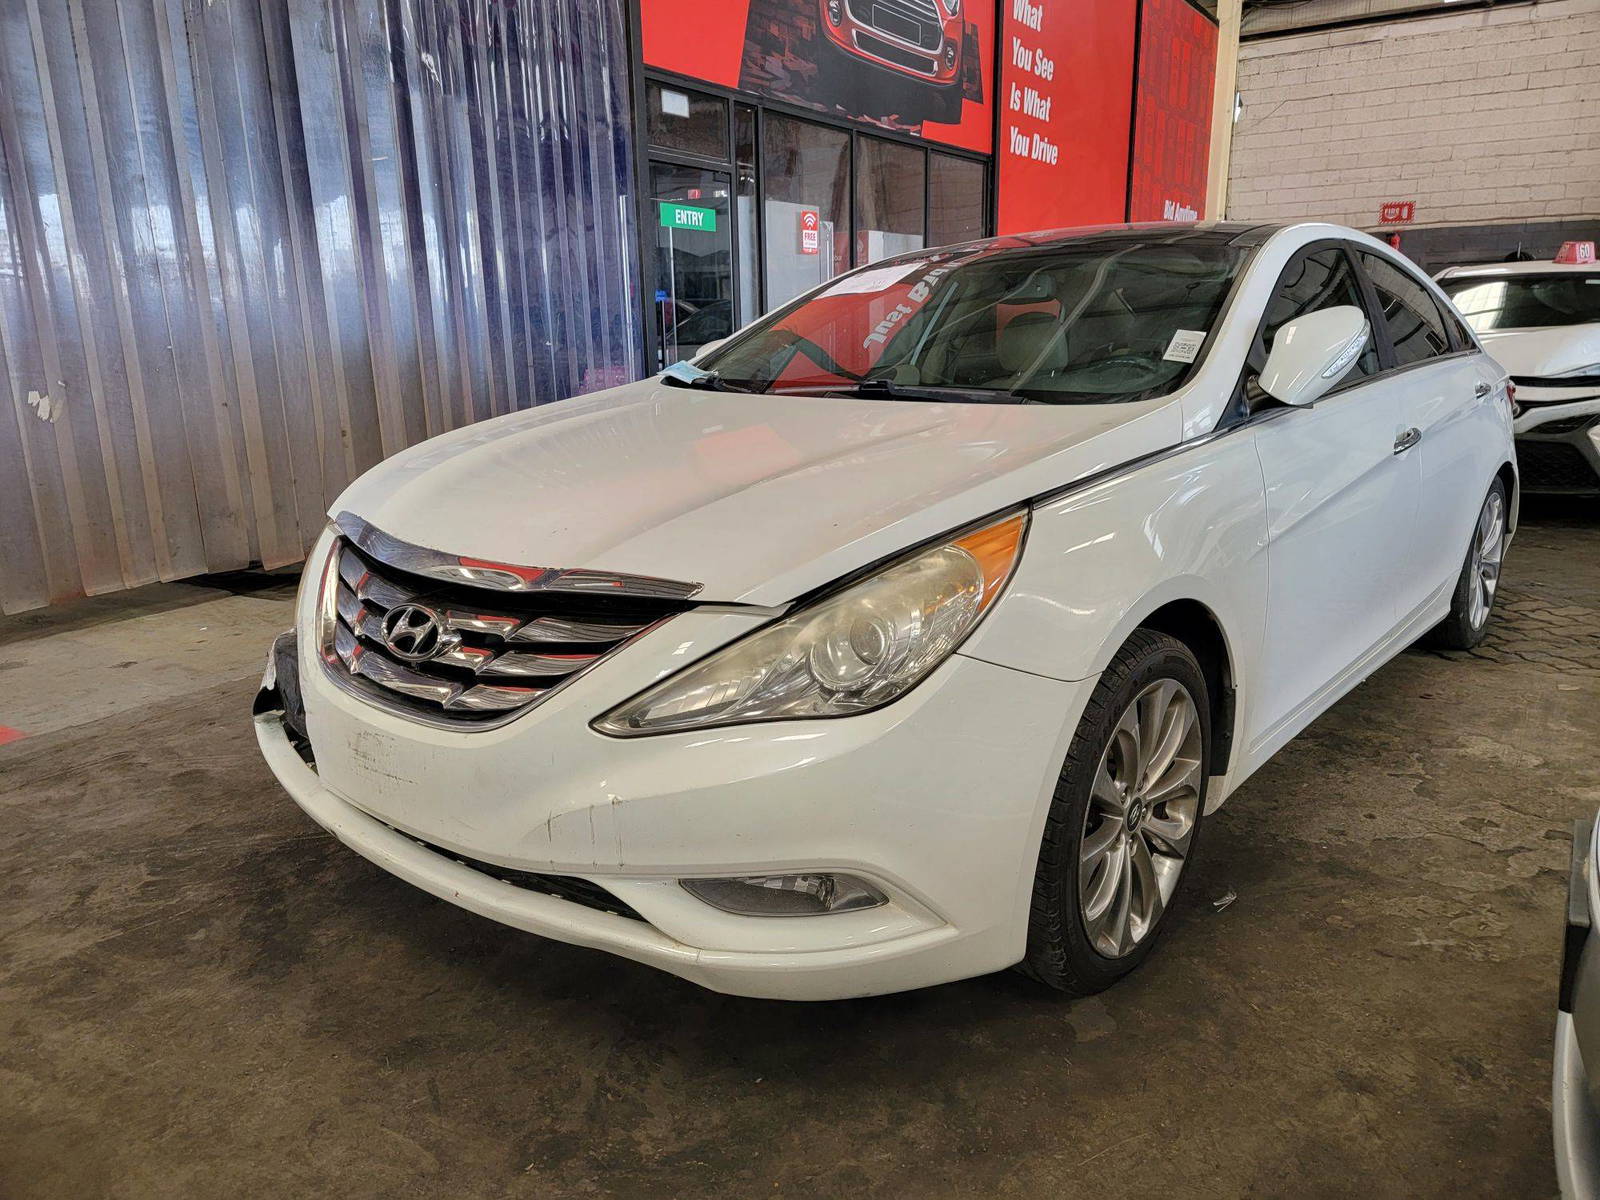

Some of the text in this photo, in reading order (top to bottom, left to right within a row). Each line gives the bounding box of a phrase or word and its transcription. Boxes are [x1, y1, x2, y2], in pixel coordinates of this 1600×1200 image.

[1012, 0, 1043, 32] What
[1011, 36, 1054, 81] You See
[1009, 82, 1051, 122] Is What
[1009, 126, 1058, 166] You Drive
[675, 208, 704, 227] ENTRY
[804, 232, 817, 241] FREE
[1579, 244, 1590, 258] 60
